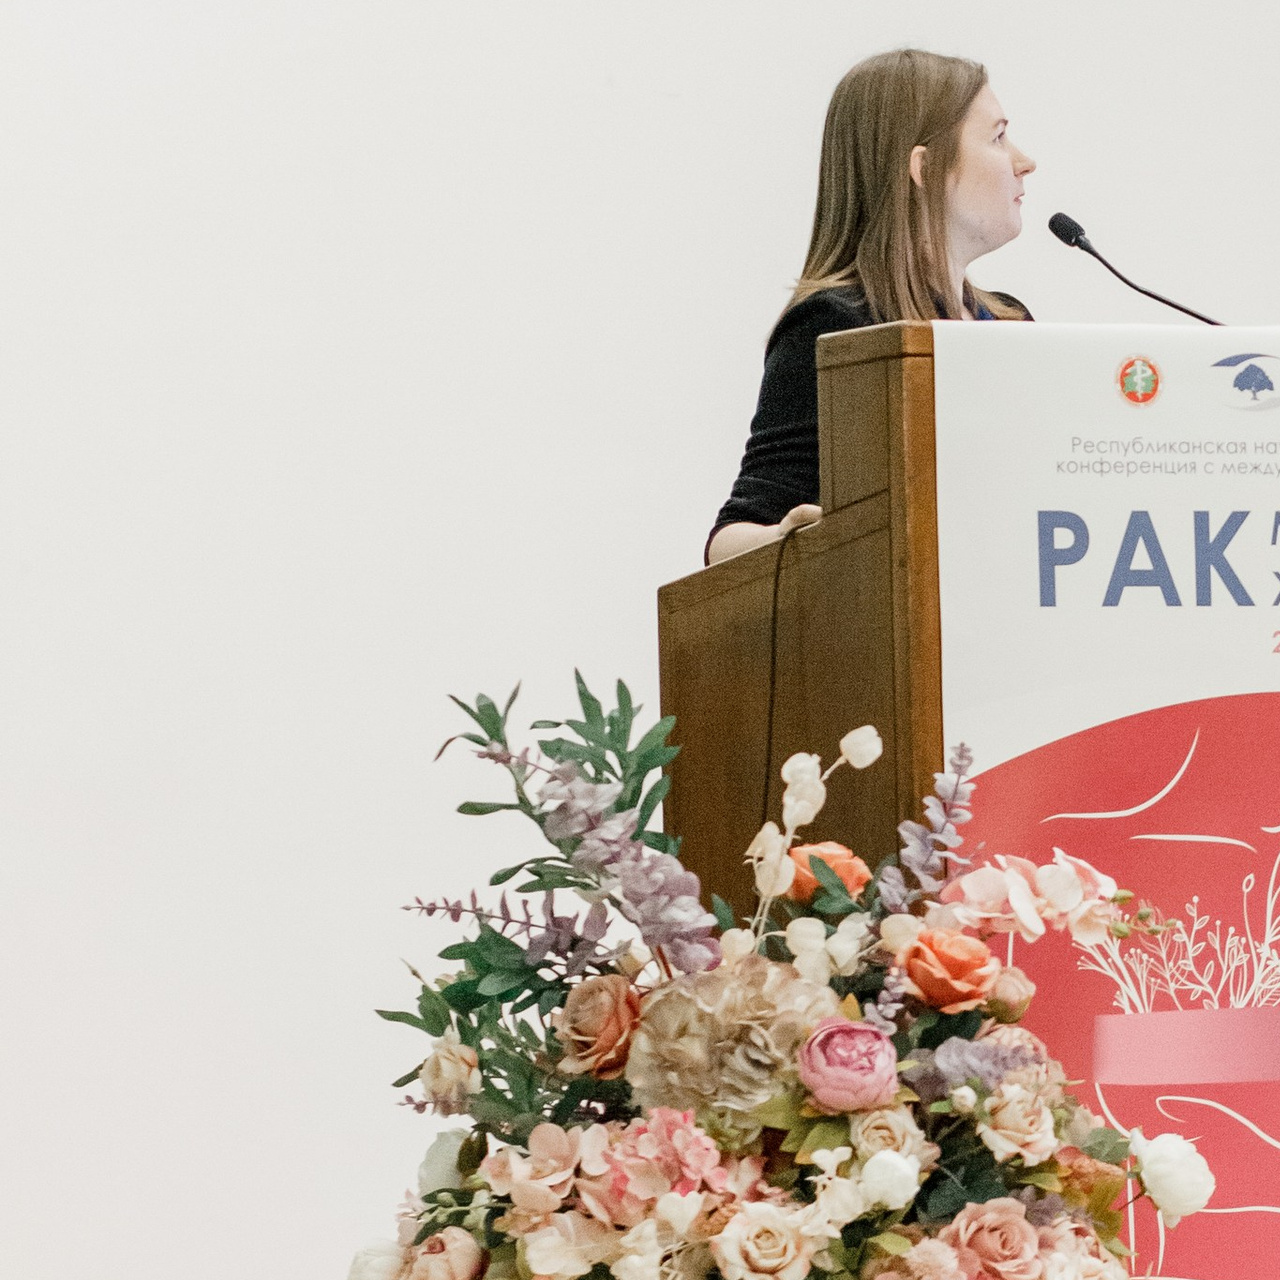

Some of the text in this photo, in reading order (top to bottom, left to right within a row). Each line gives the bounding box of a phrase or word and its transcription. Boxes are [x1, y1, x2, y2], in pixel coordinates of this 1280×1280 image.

[1071, 436, 1247, 457] Республиканская
[1056, 457, 1197, 477] конференция
[1203, 461, 1213, 474] с
[1037, 510, 1255, 608] РАК
